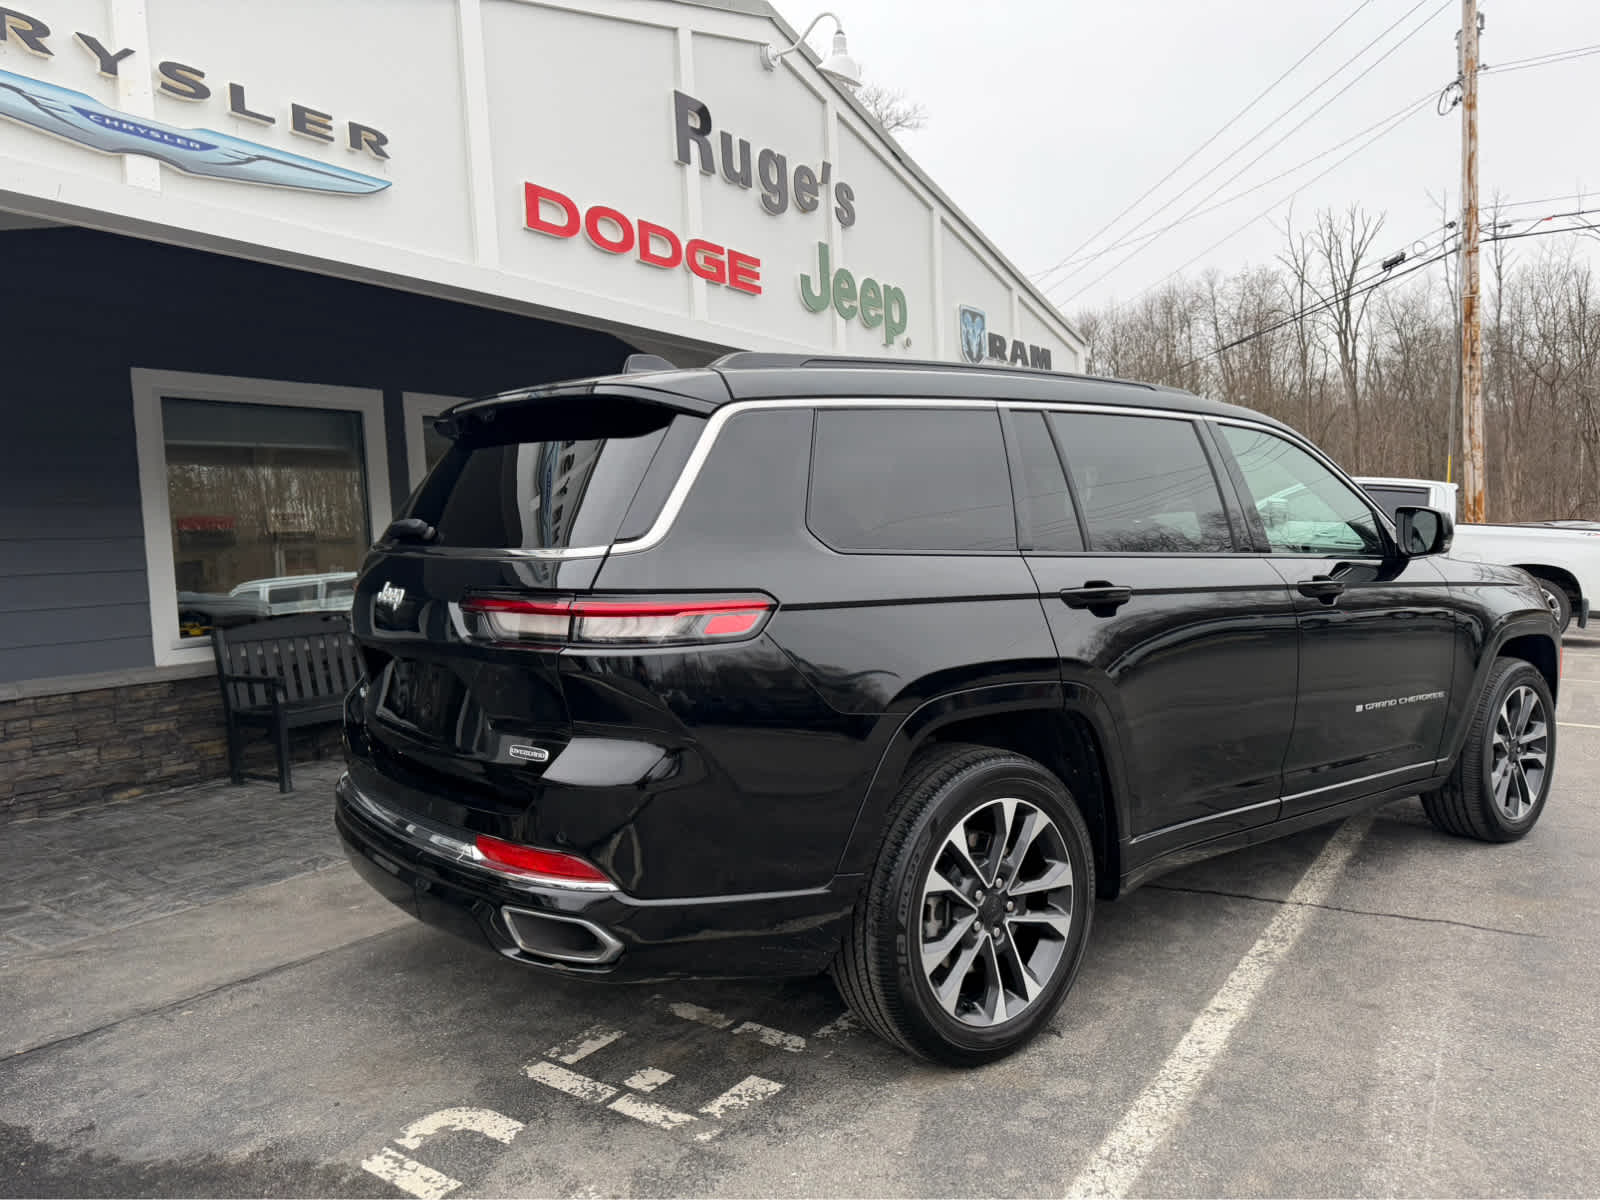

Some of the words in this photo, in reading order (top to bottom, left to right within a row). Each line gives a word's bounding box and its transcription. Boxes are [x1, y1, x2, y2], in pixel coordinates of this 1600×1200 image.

[88, 114, 201, 149] CHRYSLER
[673, 89, 856, 228] Ruge's
[523, 181, 762, 295] DODGE
[987, 331, 1052, 371] RAM
[377, 581, 405, 612] Jeep
[1364, 698, 1398, 711] GRAND
[1398, 690, 1446, 705] CHEROKEE
